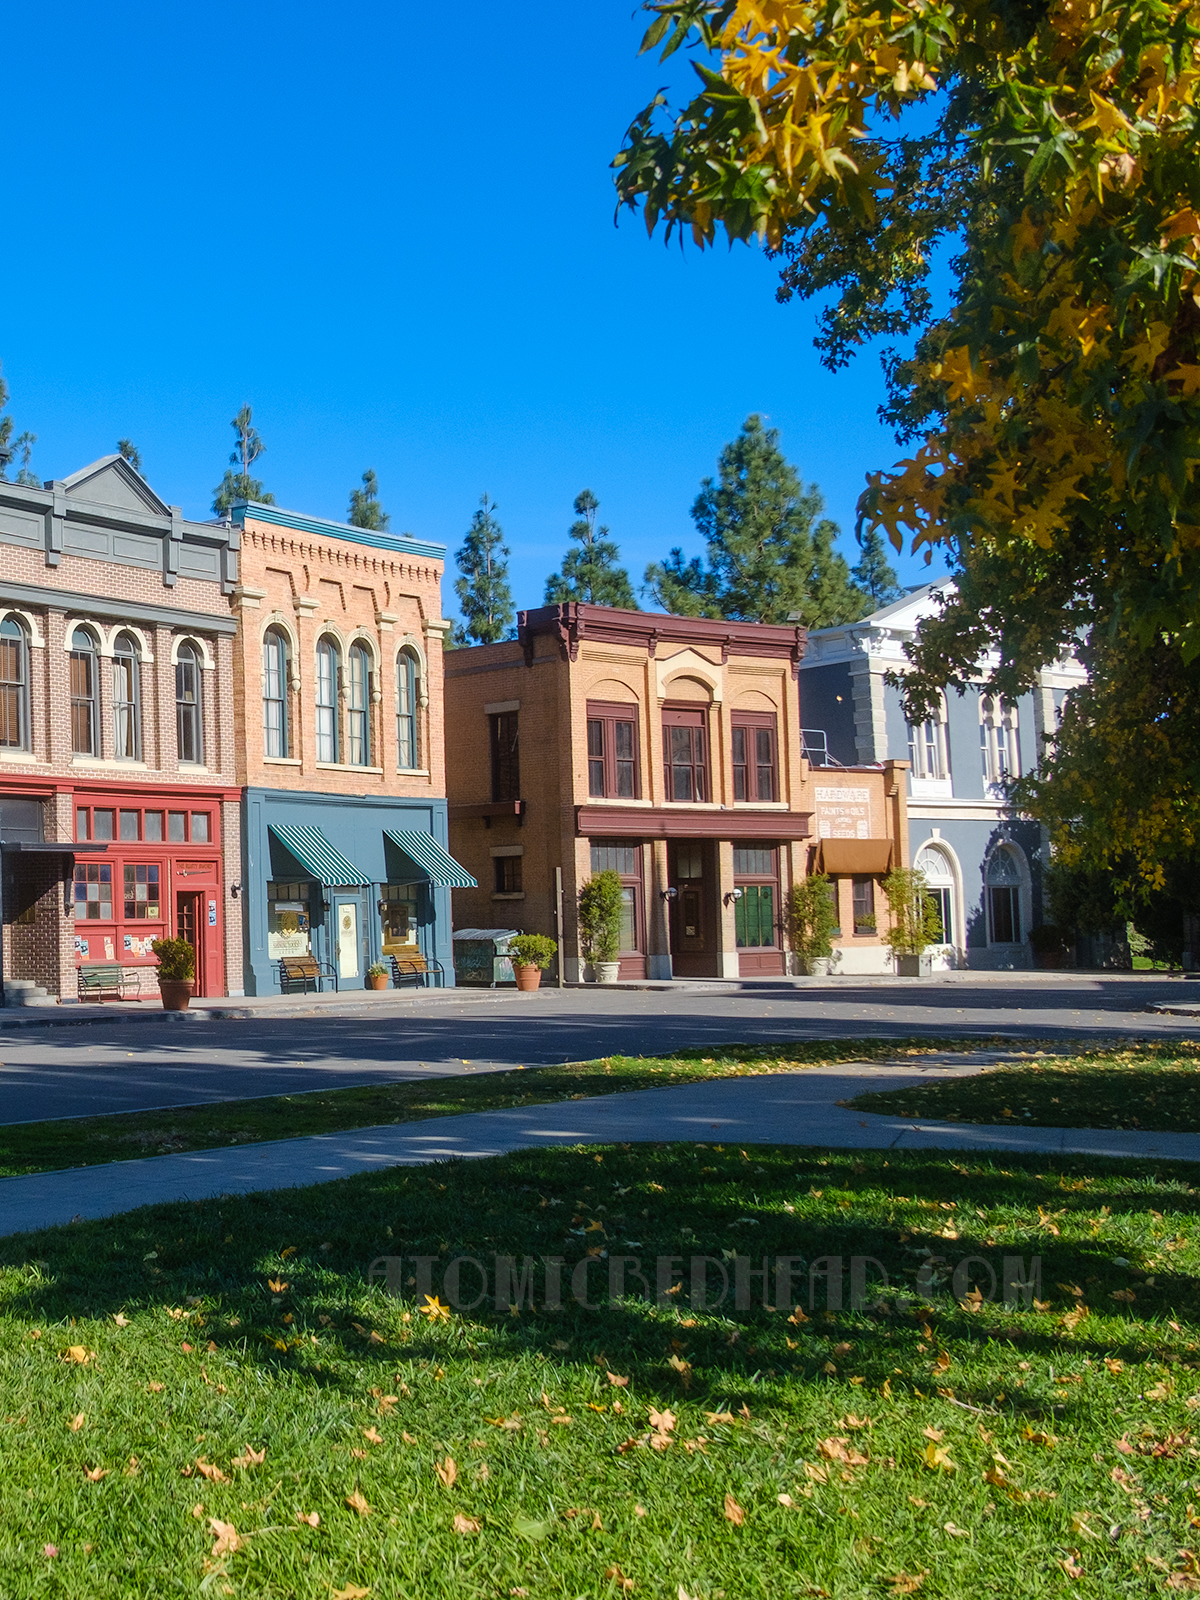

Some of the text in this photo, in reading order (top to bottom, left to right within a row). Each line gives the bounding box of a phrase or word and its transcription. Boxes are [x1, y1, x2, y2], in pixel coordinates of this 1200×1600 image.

[816, 789, 868, 800] HARDWARE
[821, 807, 845, 815] PAINTS
[851, 807, 864, 815] OILS
[833, 830, 855, 838] SEEDS
